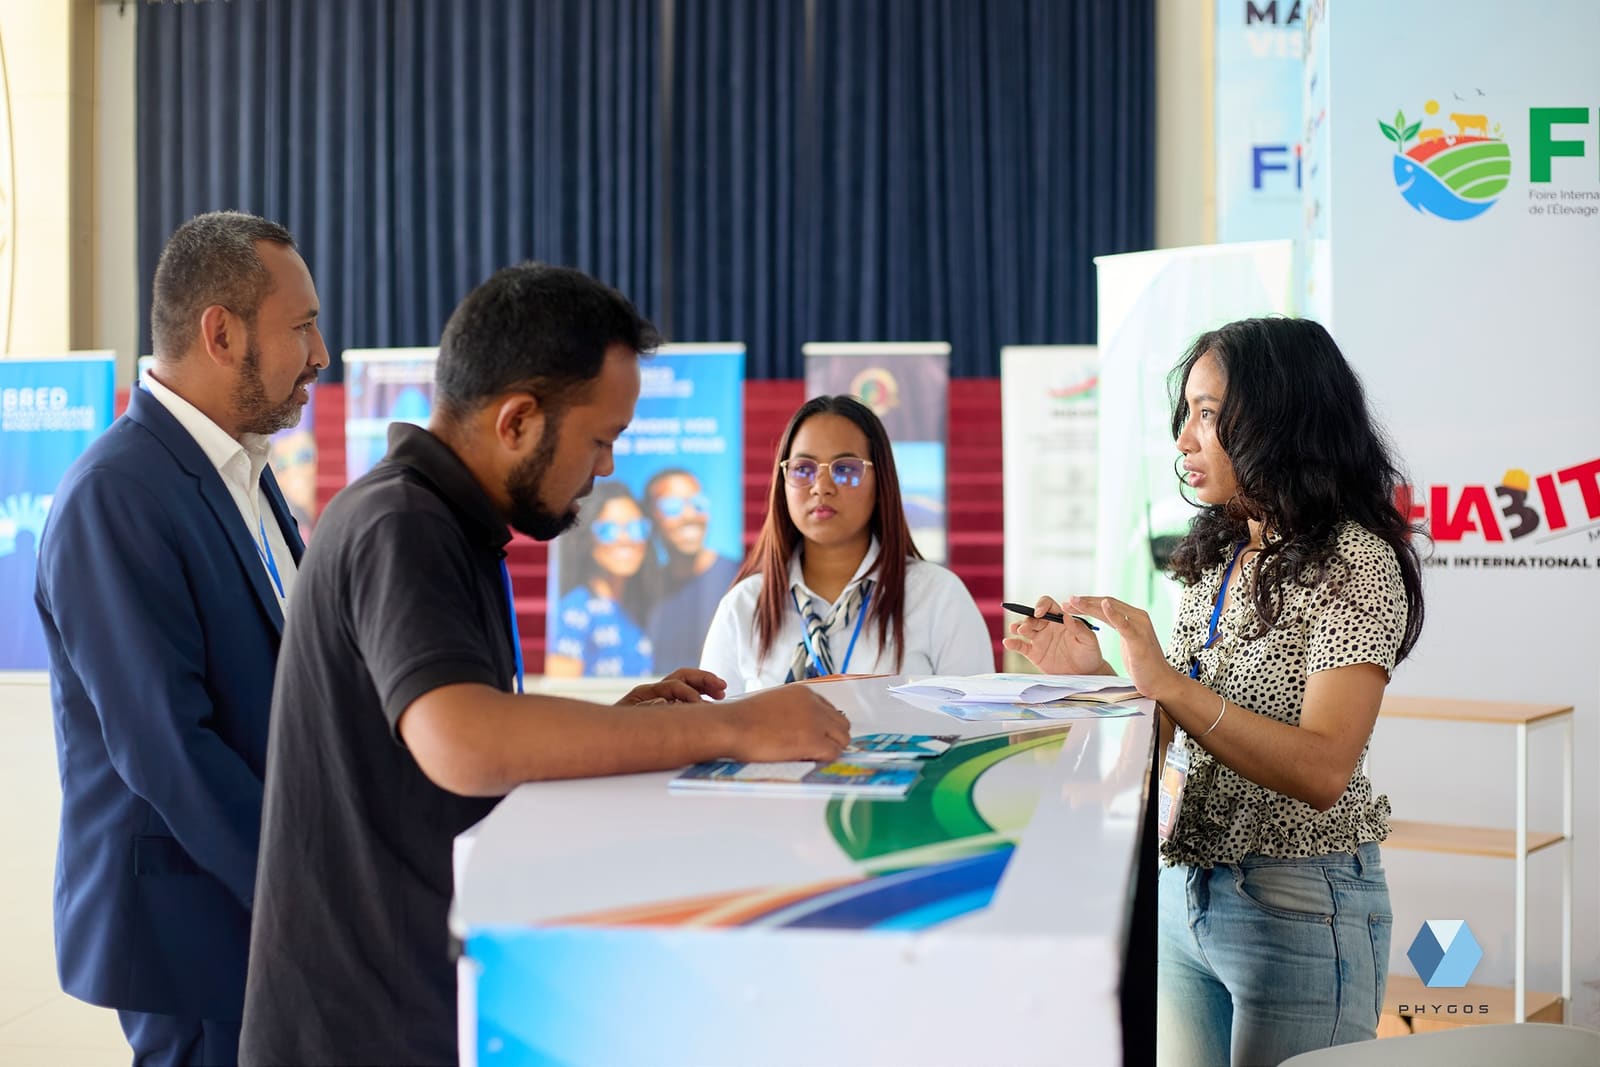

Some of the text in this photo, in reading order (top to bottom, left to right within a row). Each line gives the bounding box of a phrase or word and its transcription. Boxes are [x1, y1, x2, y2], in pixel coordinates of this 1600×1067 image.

[1528, 190, 1557, 200] Foire
[1528, 205, 1545, 216] de
[1454, 557, 1592, 569] INTERNATIONAL
